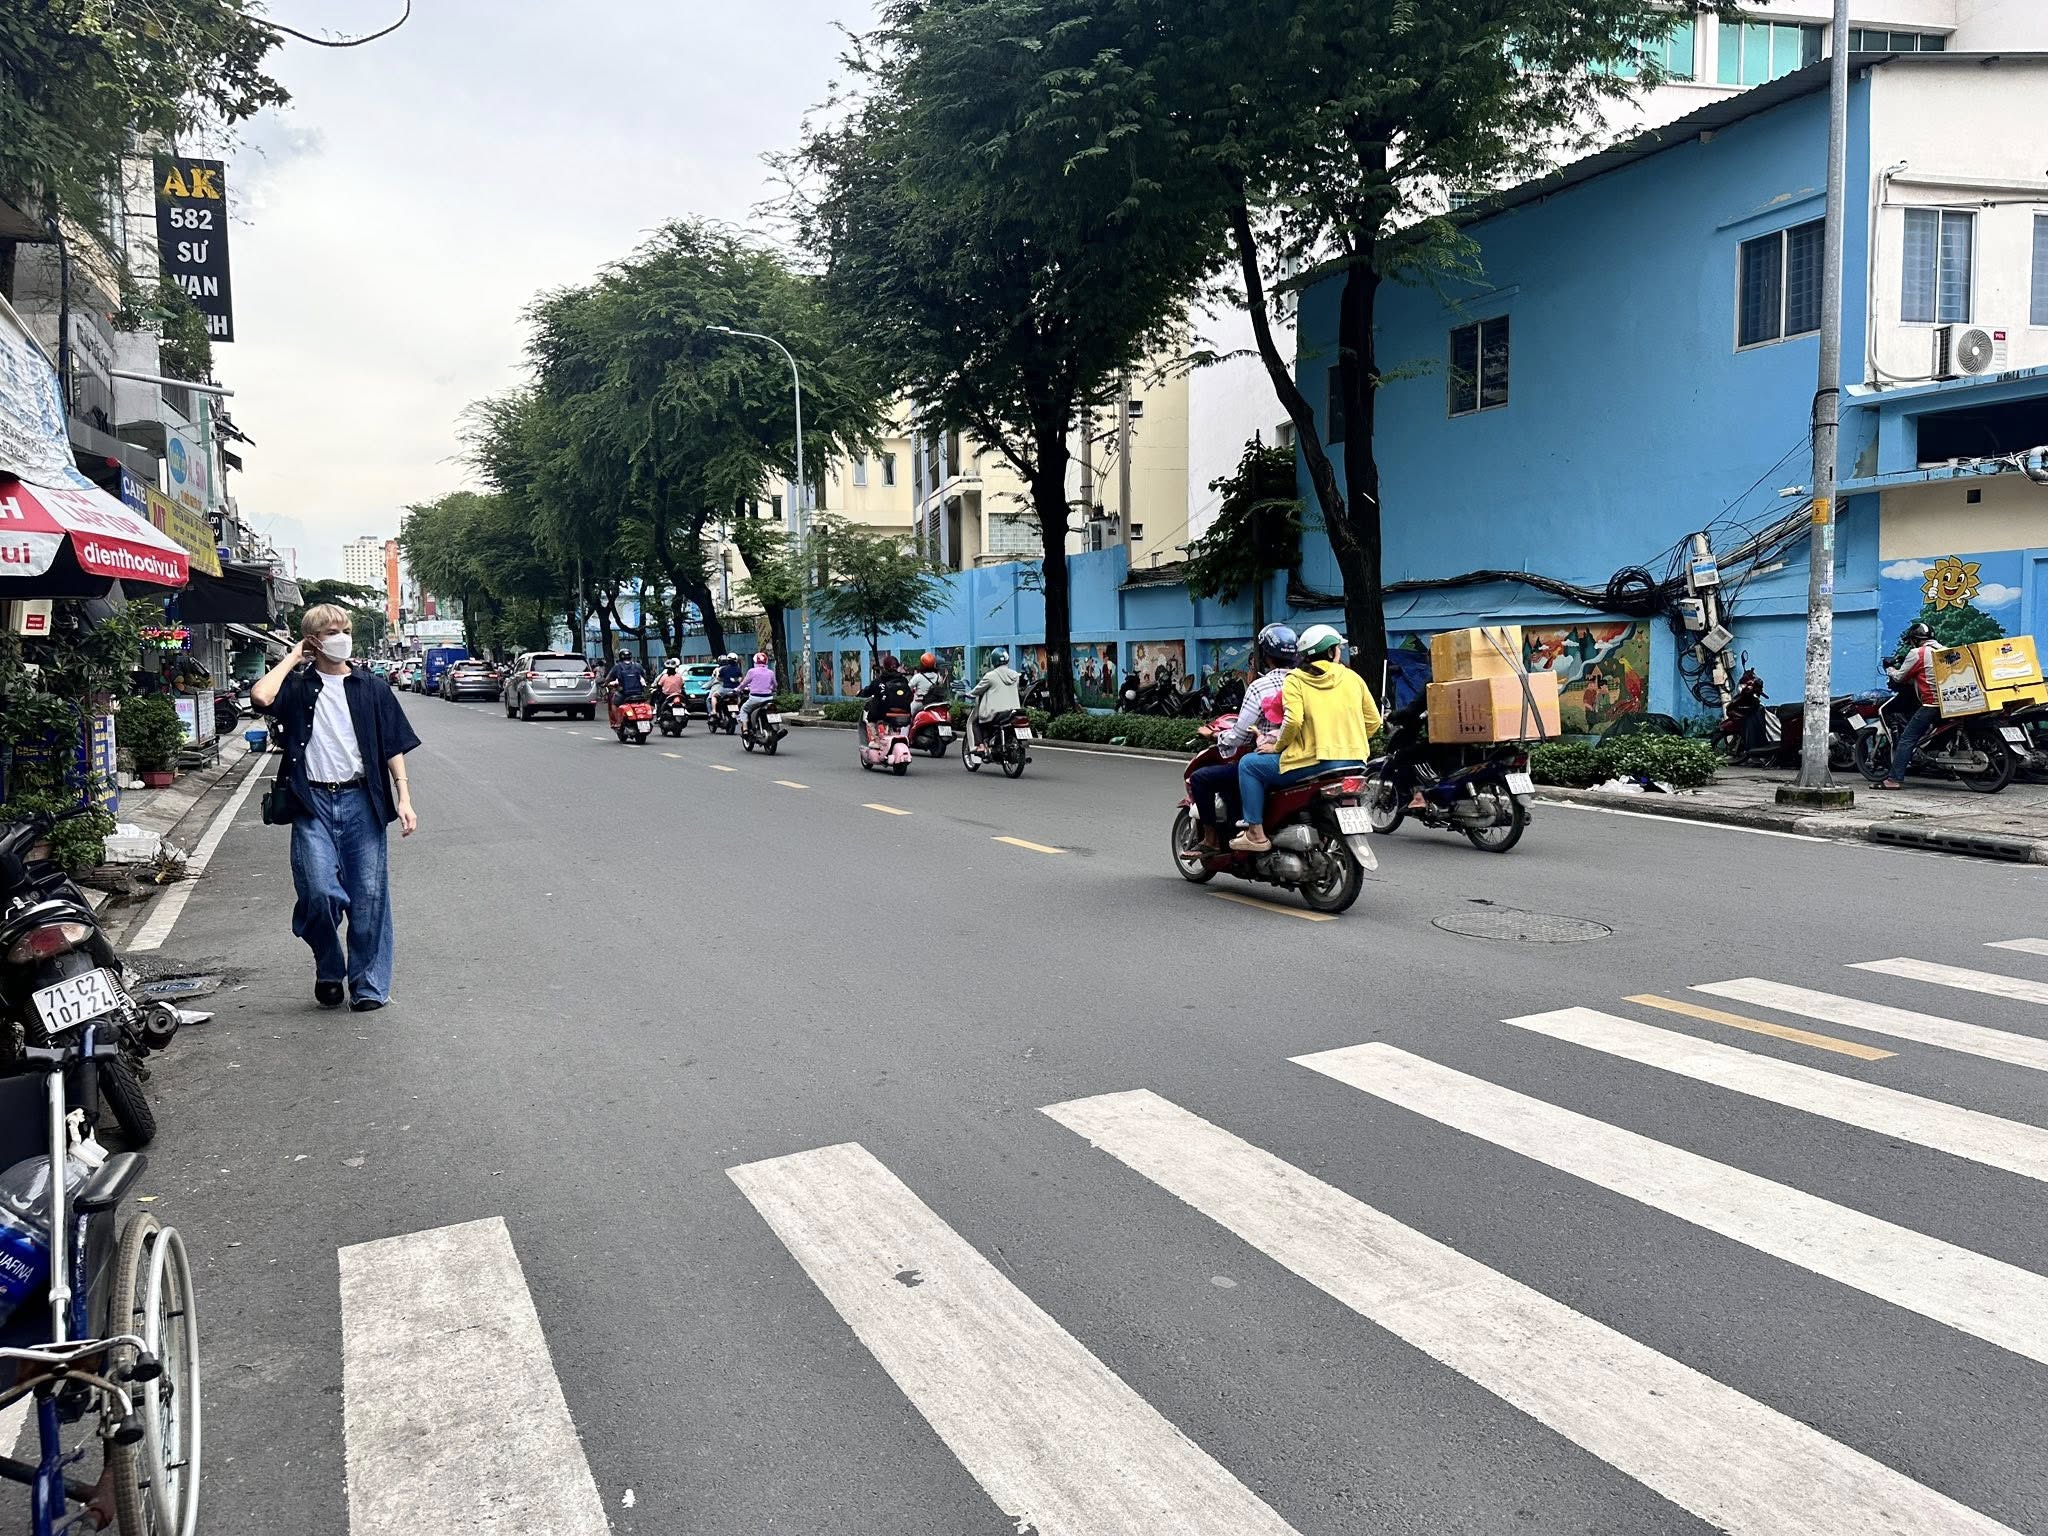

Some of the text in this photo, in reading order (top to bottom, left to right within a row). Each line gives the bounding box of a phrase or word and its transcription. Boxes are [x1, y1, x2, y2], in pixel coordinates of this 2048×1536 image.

[163, 166, 220, 199] AK
[170, 208, 213, 230] 582
[177, 239, 208, 263] SƯ
[51, 500, 145, 536] LAPTOP
[83, 541, 181, 578] dienthoaivui
[44, 975, 101, 1010] 71-C2
[46, 993, 114, 1029] 107.24
